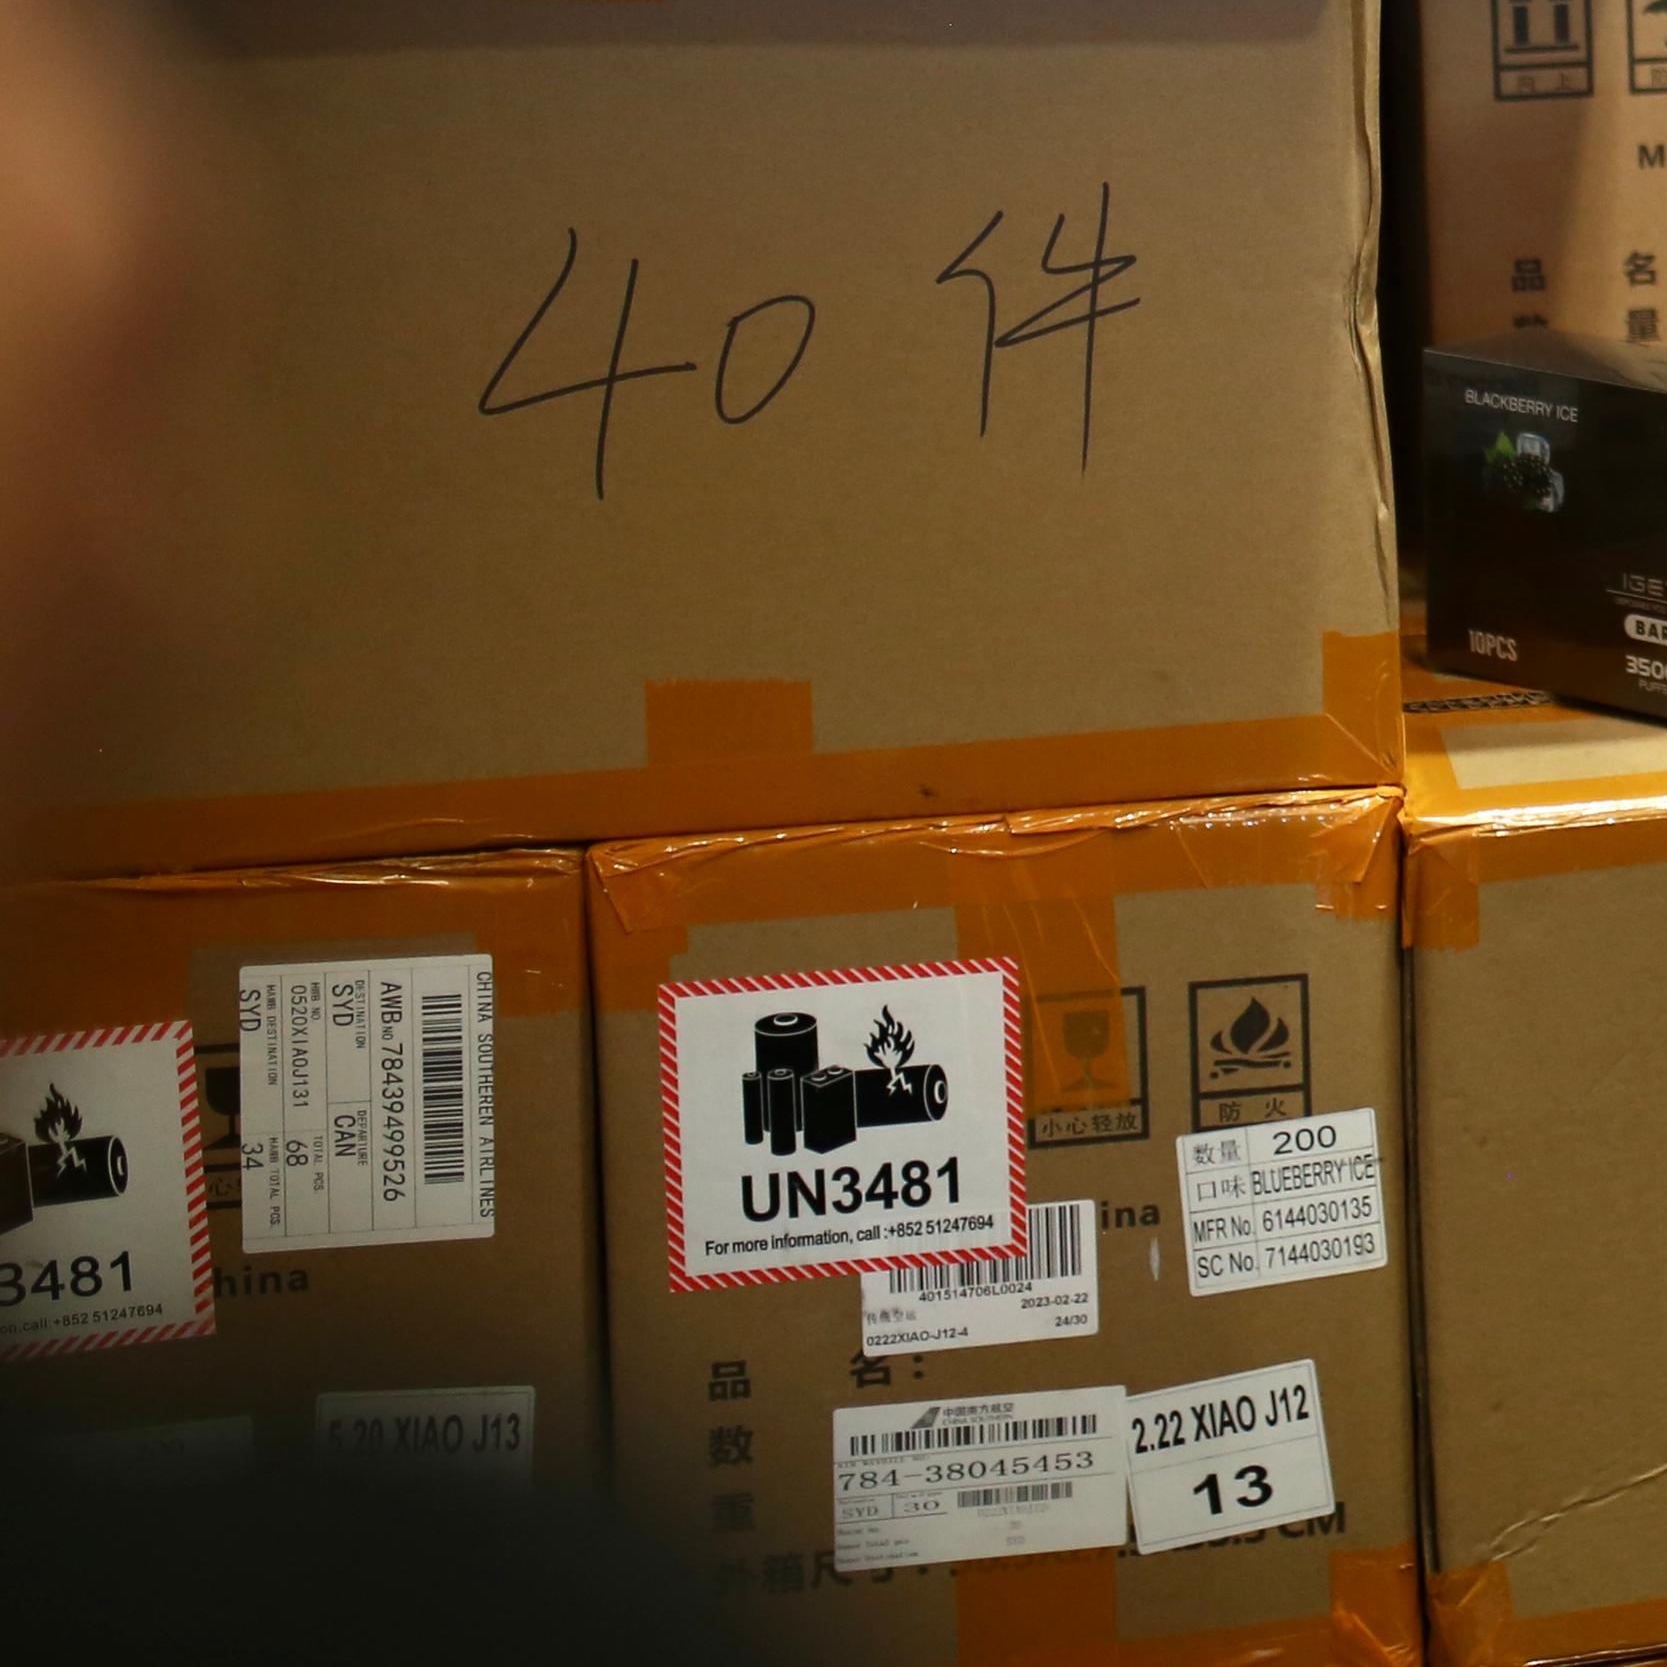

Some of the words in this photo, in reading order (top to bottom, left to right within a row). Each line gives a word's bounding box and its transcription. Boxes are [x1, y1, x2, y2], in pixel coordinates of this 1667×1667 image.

[1511, 258, 1547, 292] 品
[478, 226, 816, 499] 40
[1465, 388, 1554, 418] BLACKBERRY
[1556, 404, 1580, 424] ICE
[1468, 628, 1518, 662] 10PCS
[240, 989, 261, 1032] SYD
[332, 984, 353, 1026] SYD
[355, 980, 366, 1049] DESTINATION
[380, 982, 402, 1024] AWB
[477, 972, 493, 1023] CHINA
[267, 1016, 277, 1086] DESTINATION
[382, 1026, 394, 1040] NO
[478, 1034, 493, 1126] SOUTHEREN
[381, 1043, 405, 1202] 78439499526
[1041, 1111, 1141, 1139] 小心轻放
[1218, 1097, 1289, 1123] 防火
[241, 1142, 263, 1171] 34
[285, 1140, 308, 1167] 68
[312, 1135, 323, 1166] TOTAL
[334, 1114, 355, 1158] CAN
[356, 1110, 368, 1166] DEPARTURE
[1192, 1139, 1243, 1166] 数量
[1271, 1125, 1338, 1156] 200
[269, 1169, 279, 1200] TOTAL
[479, 1136, 494, 1218] AIRLINES
[741, 1156, 960, 1223] UN3481
[1195, 1174, 1249, 1204] 口味
[1250, 1159, 1345, 1199] BLUEBERRY
[1348, 1152, 1377, 1182] ICE
[705, 1238, 730, 1256] For
[732, 1237, 769, 1254] more
[771, 1227, 854, 1250] information,
[856, 1224, 882, 1242] call
[925, 1213, 995, 1235] 51247694
[1100, 1201, 1161, 1231] ina
[1192, 1218, 1228, 1244] MFR
[1261, 1195, 1374, 1234] 6144030135
[1196, 1255, 1226, 1280] SC
[1265, 1232, 1377, 1270] 7144030193
[213, 1264, 309, 1297] hina
[918, 1282, 1033, 1304] 401514706L0024
[1020, 1292, 1090, 1310] 2023-02-22
[92, 1302, 164, 1324] 51247694
[1054, 1313, 1089, 1328] 24/30
[865, 1327, 969, 1348] 0222XIAO-J12-4
[706, 1360, 753, 1403] 品
[941, 1401, 1015, 1418] 中国南方航空
[1131, 1409, 1186, 1454] 2.22
[1190, 1394, 1257, 1442] XIAO
[1264, 1384, 1310, 1427] J12
[393, 1415, 465, 1453] XIAO
[470, 1410, 523, 1452] J13
[838, 1449, 1095, 1493] 784-38045453
[1192, 1464, 1274, 1516] 13
[841, 1505, 879, 1519] SYD
[903, 1499, 941, 1513] 30
